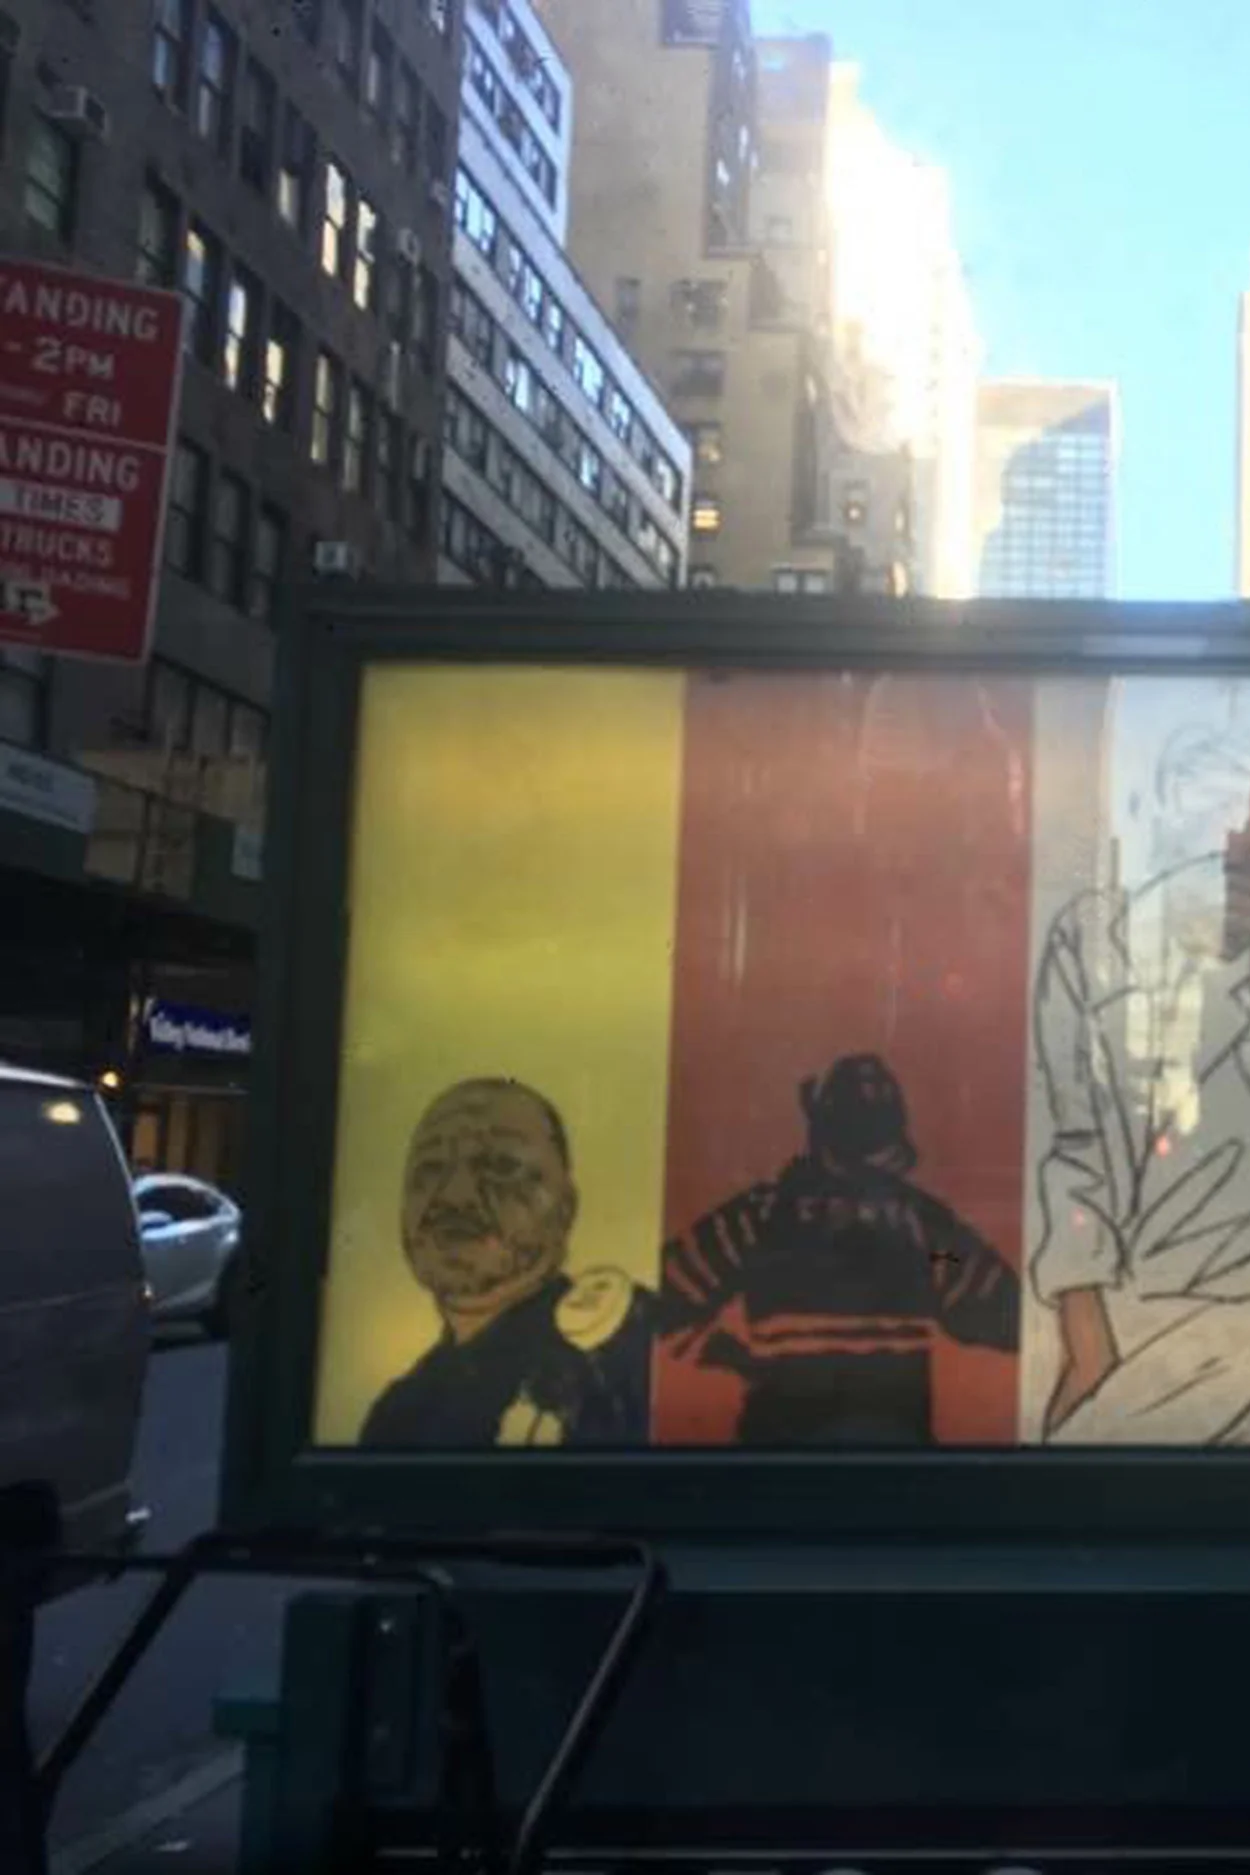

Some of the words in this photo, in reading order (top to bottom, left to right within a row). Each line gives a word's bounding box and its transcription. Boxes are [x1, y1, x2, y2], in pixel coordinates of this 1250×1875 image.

[0, 274, 160, 342] ANDING
[30, 334, 117, 381] 2PM
[62, 389, 123, 429] FRI
